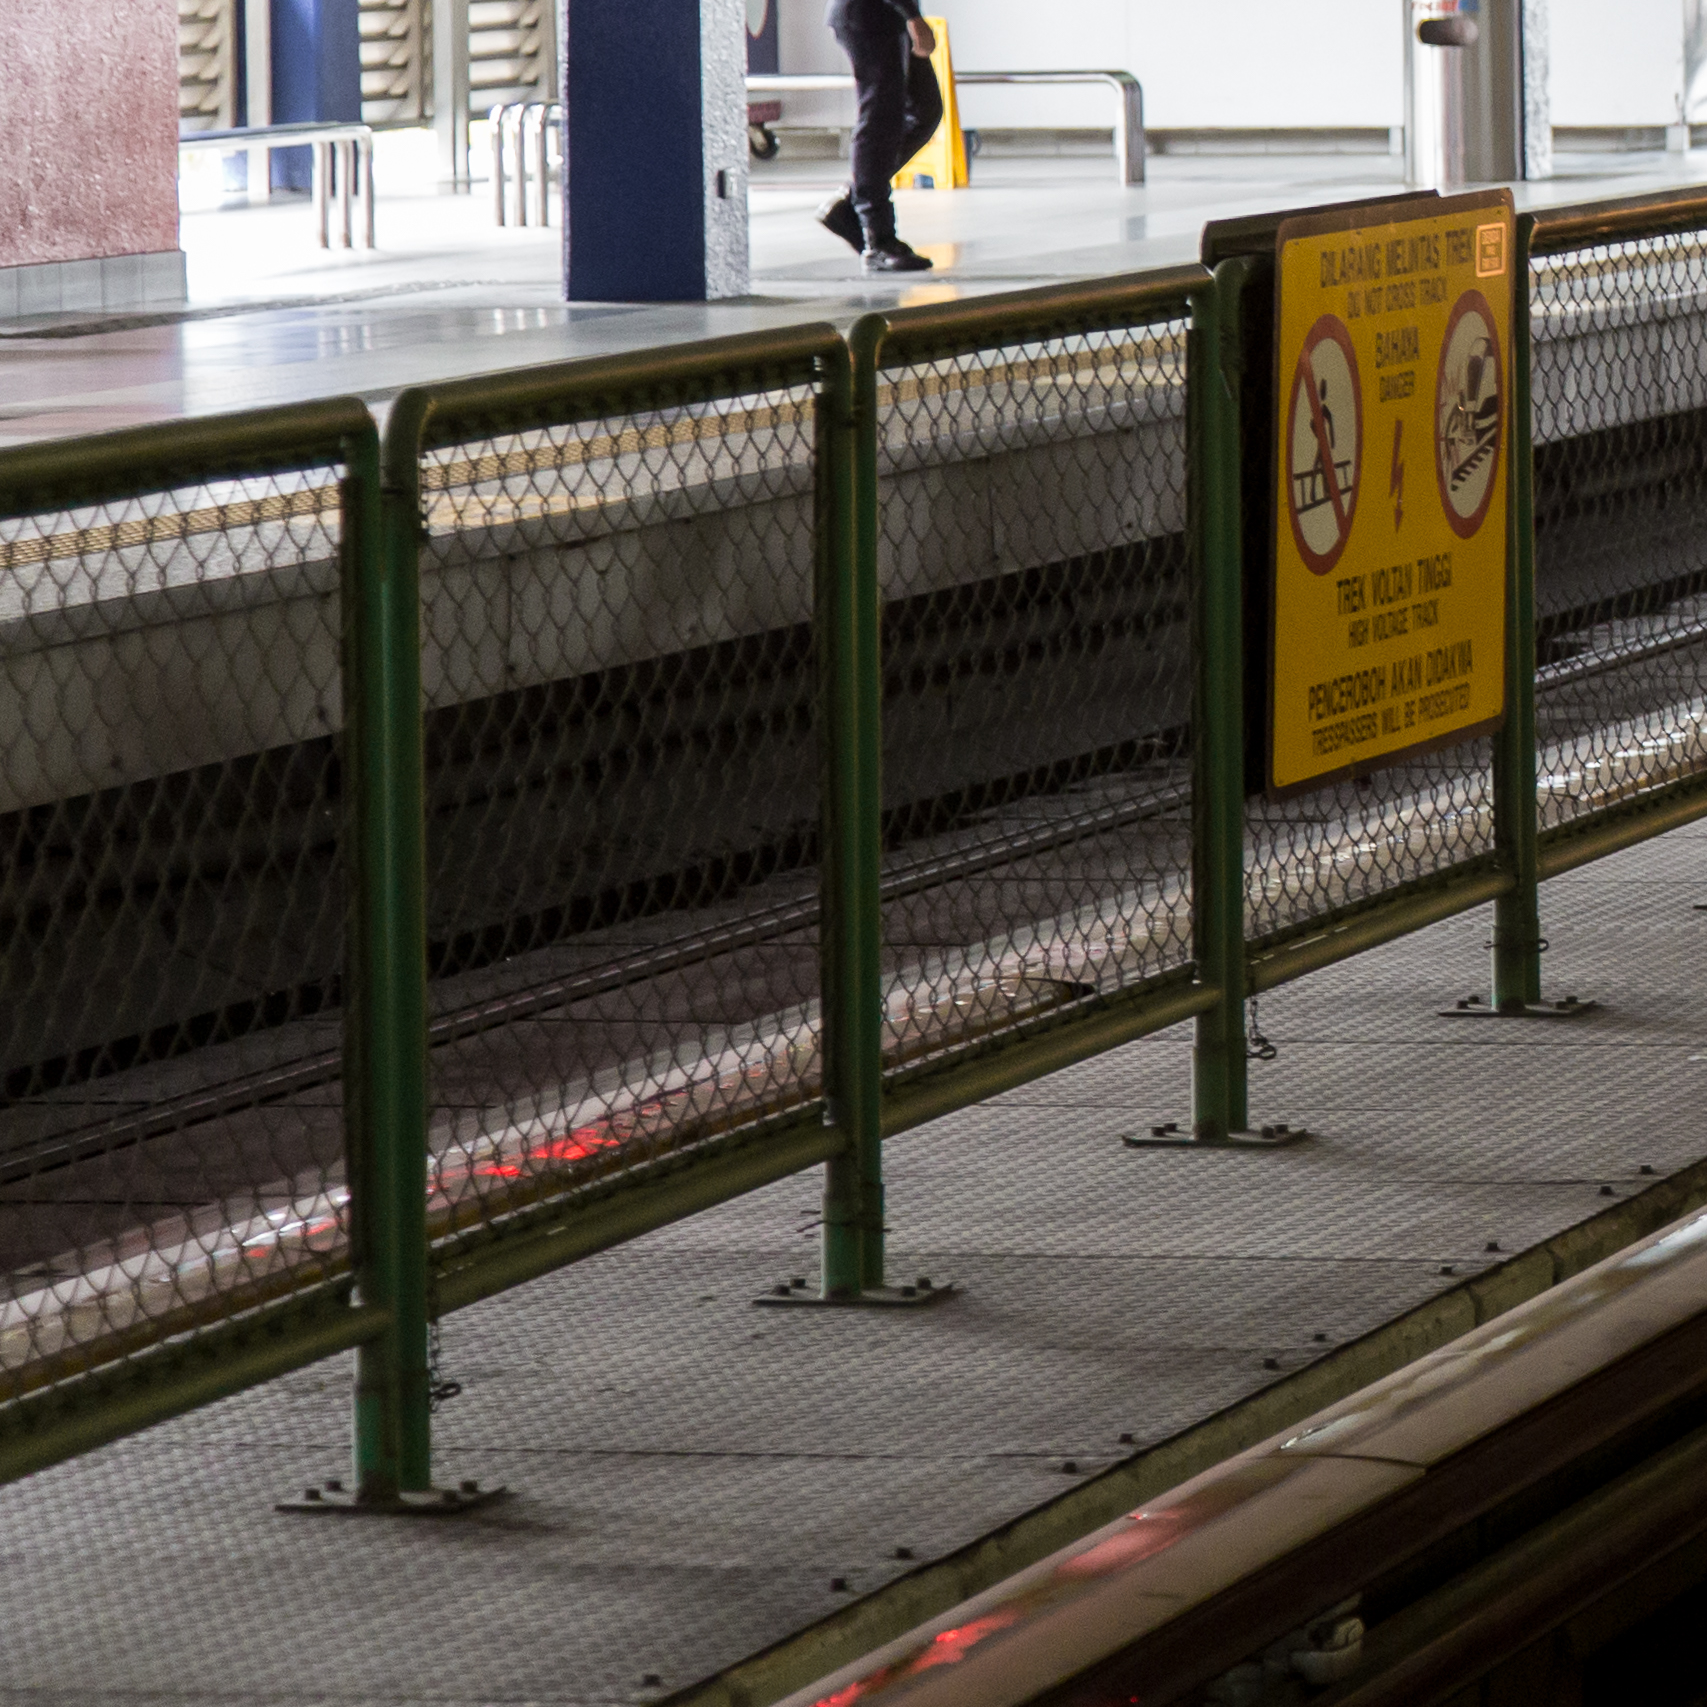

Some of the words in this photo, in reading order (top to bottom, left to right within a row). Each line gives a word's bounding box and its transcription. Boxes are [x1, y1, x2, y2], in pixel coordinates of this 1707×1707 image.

[1320, 243, 1383, 289] DILARANG
[1385, 234, 1440, 277] MELINTAS
[1375, 326, 1420, 369] BAHAYA
[1336, 574, 1367, 616] TREK
[1371, 563, 1412, 607] VOLTAN
[1417, 551, 1452, 594] TINGGI
[1391, 655, 1423, 698] AKAN
[1426, 639, 1474, 687] DIDAKWA
